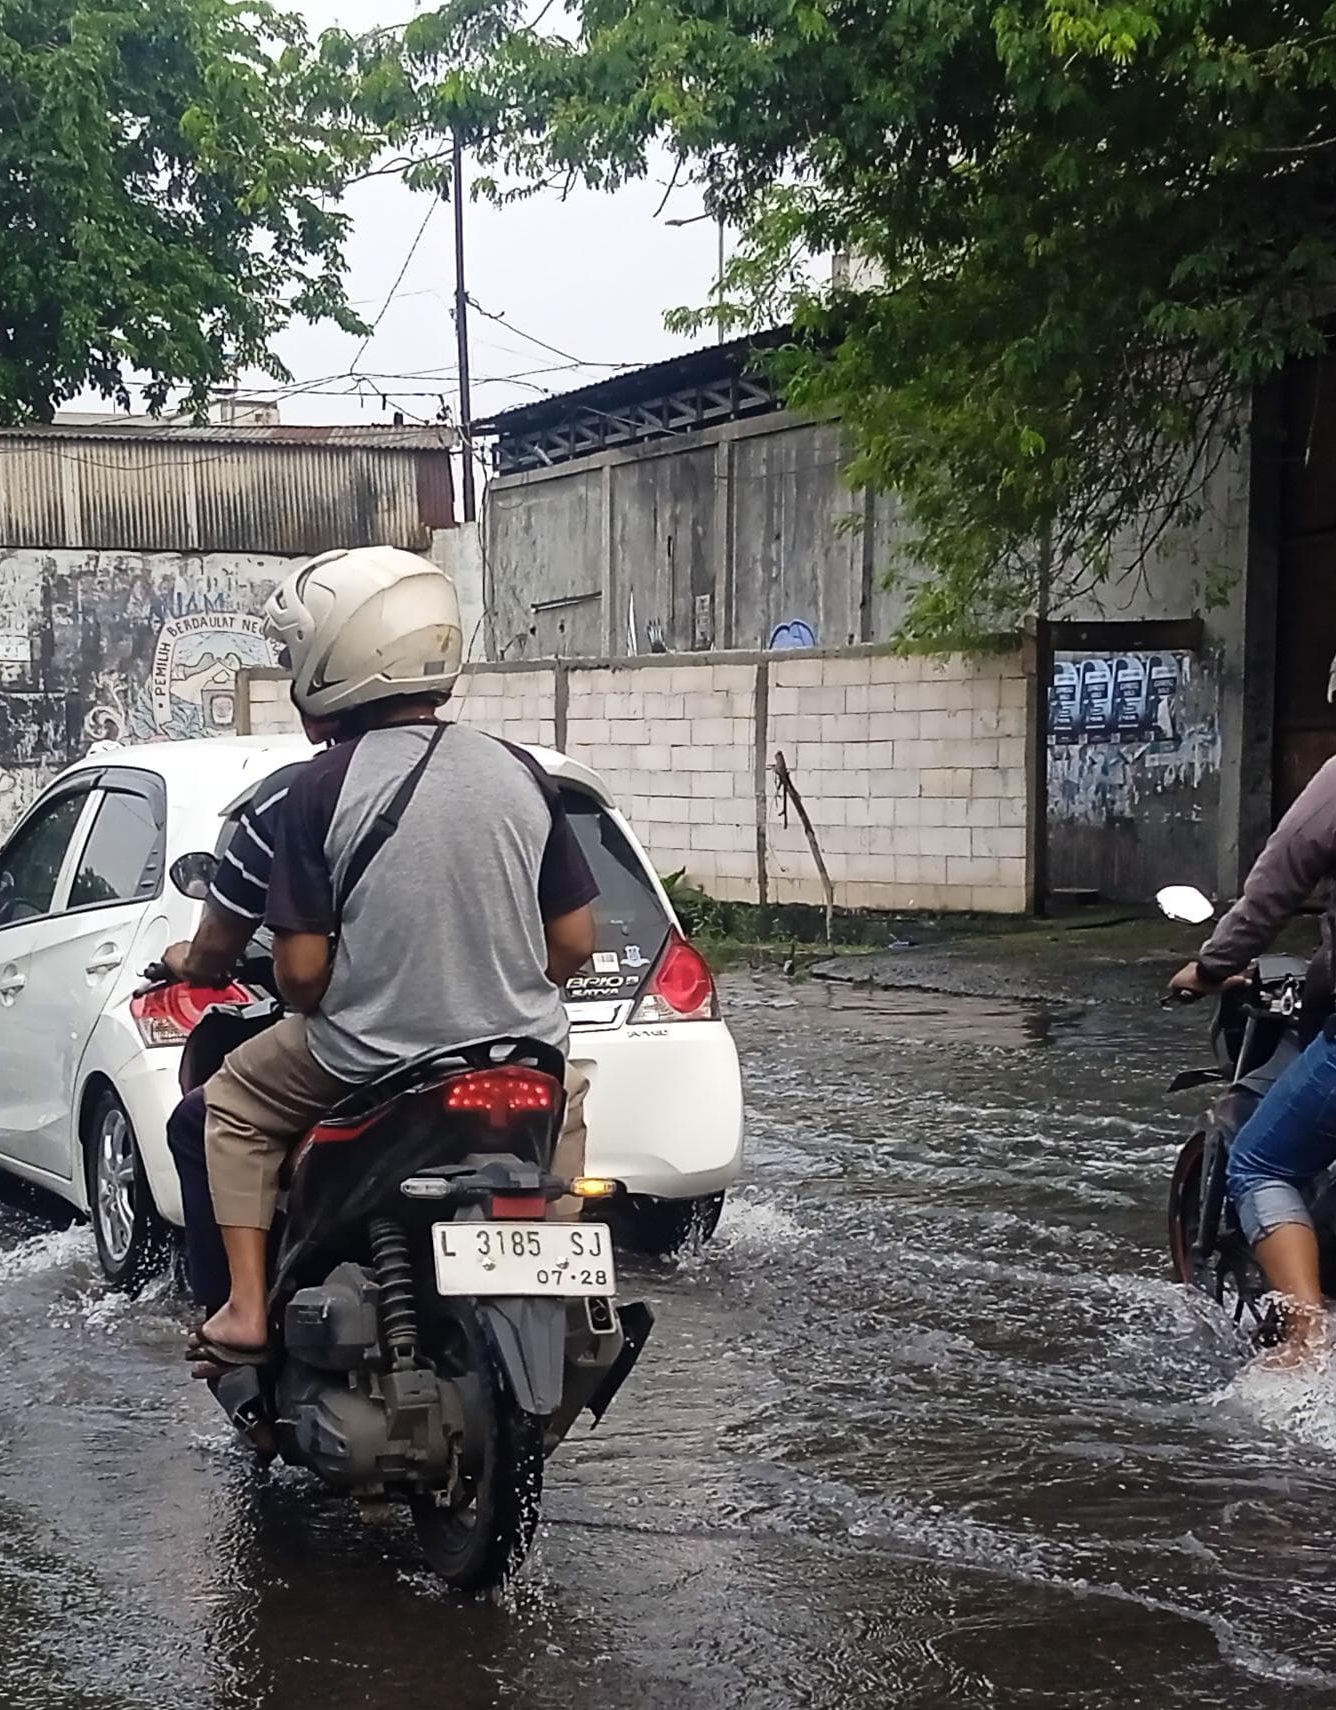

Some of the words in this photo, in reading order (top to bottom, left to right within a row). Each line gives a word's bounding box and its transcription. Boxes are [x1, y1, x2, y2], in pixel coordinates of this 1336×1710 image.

[155, 642, 171, 696] PEMILIH
[167, 617, 235, 638] BERDAULAT
[566, 976, 624, 990] BRIO
[441, 1231, 456, 1257] L
[476, 1230, 541, 1257] 3185
[571, 1231, 601, 1257] SJ
